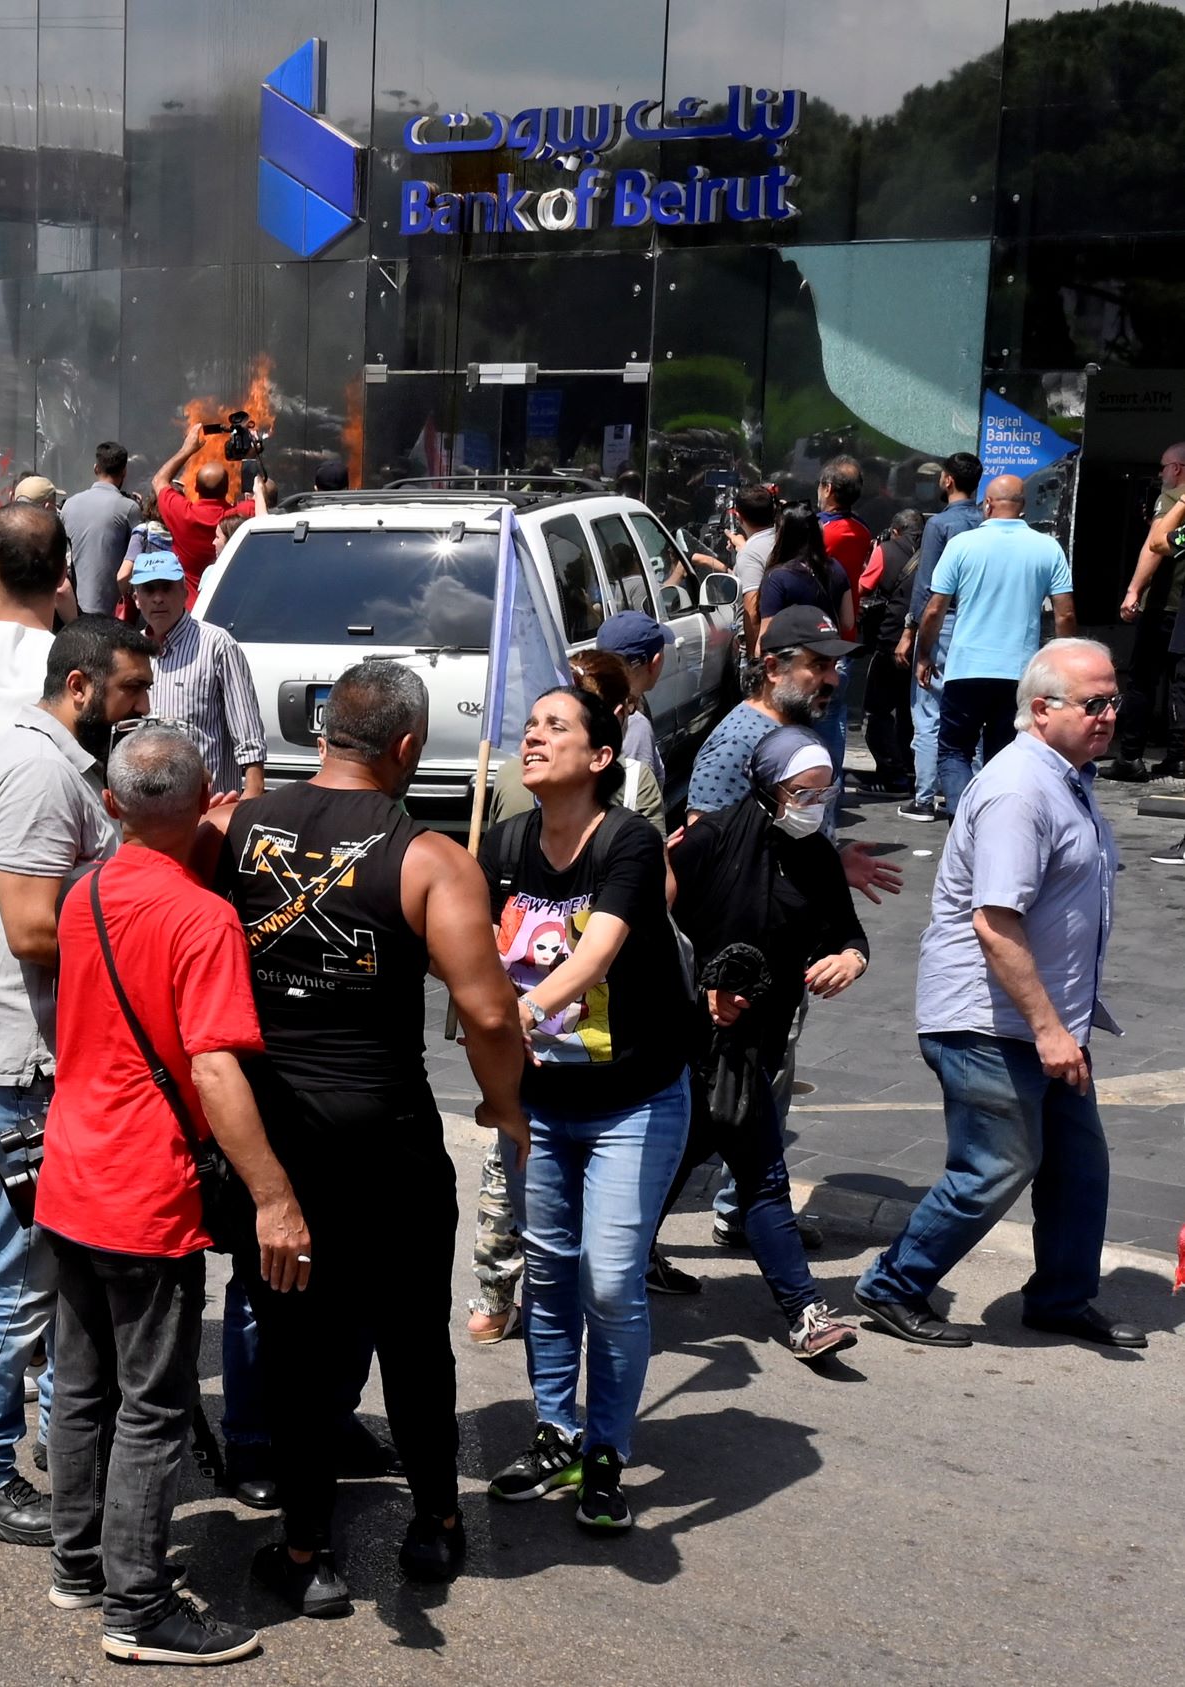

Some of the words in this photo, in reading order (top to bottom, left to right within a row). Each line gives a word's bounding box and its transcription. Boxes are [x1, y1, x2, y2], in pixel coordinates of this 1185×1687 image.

[625, 84, 806, 158] بنك
[399, 172, 539, 236] Bank
[537, 168, 610, 232] of
[612, 165, 801, 228] Beirut
[1098, 391, 1137, 404] Smart
[1142, 391, 1172, 404] ATM
[987, 416, 1022, 429] Digital
[986, 429, 1041, 445] Banking
[985, 443, 1031, 455] Services
[983, 456, 1017, 465] Available
[983, 466, 1005, 475] 24/7
[457, 701, 485, 718] QX
